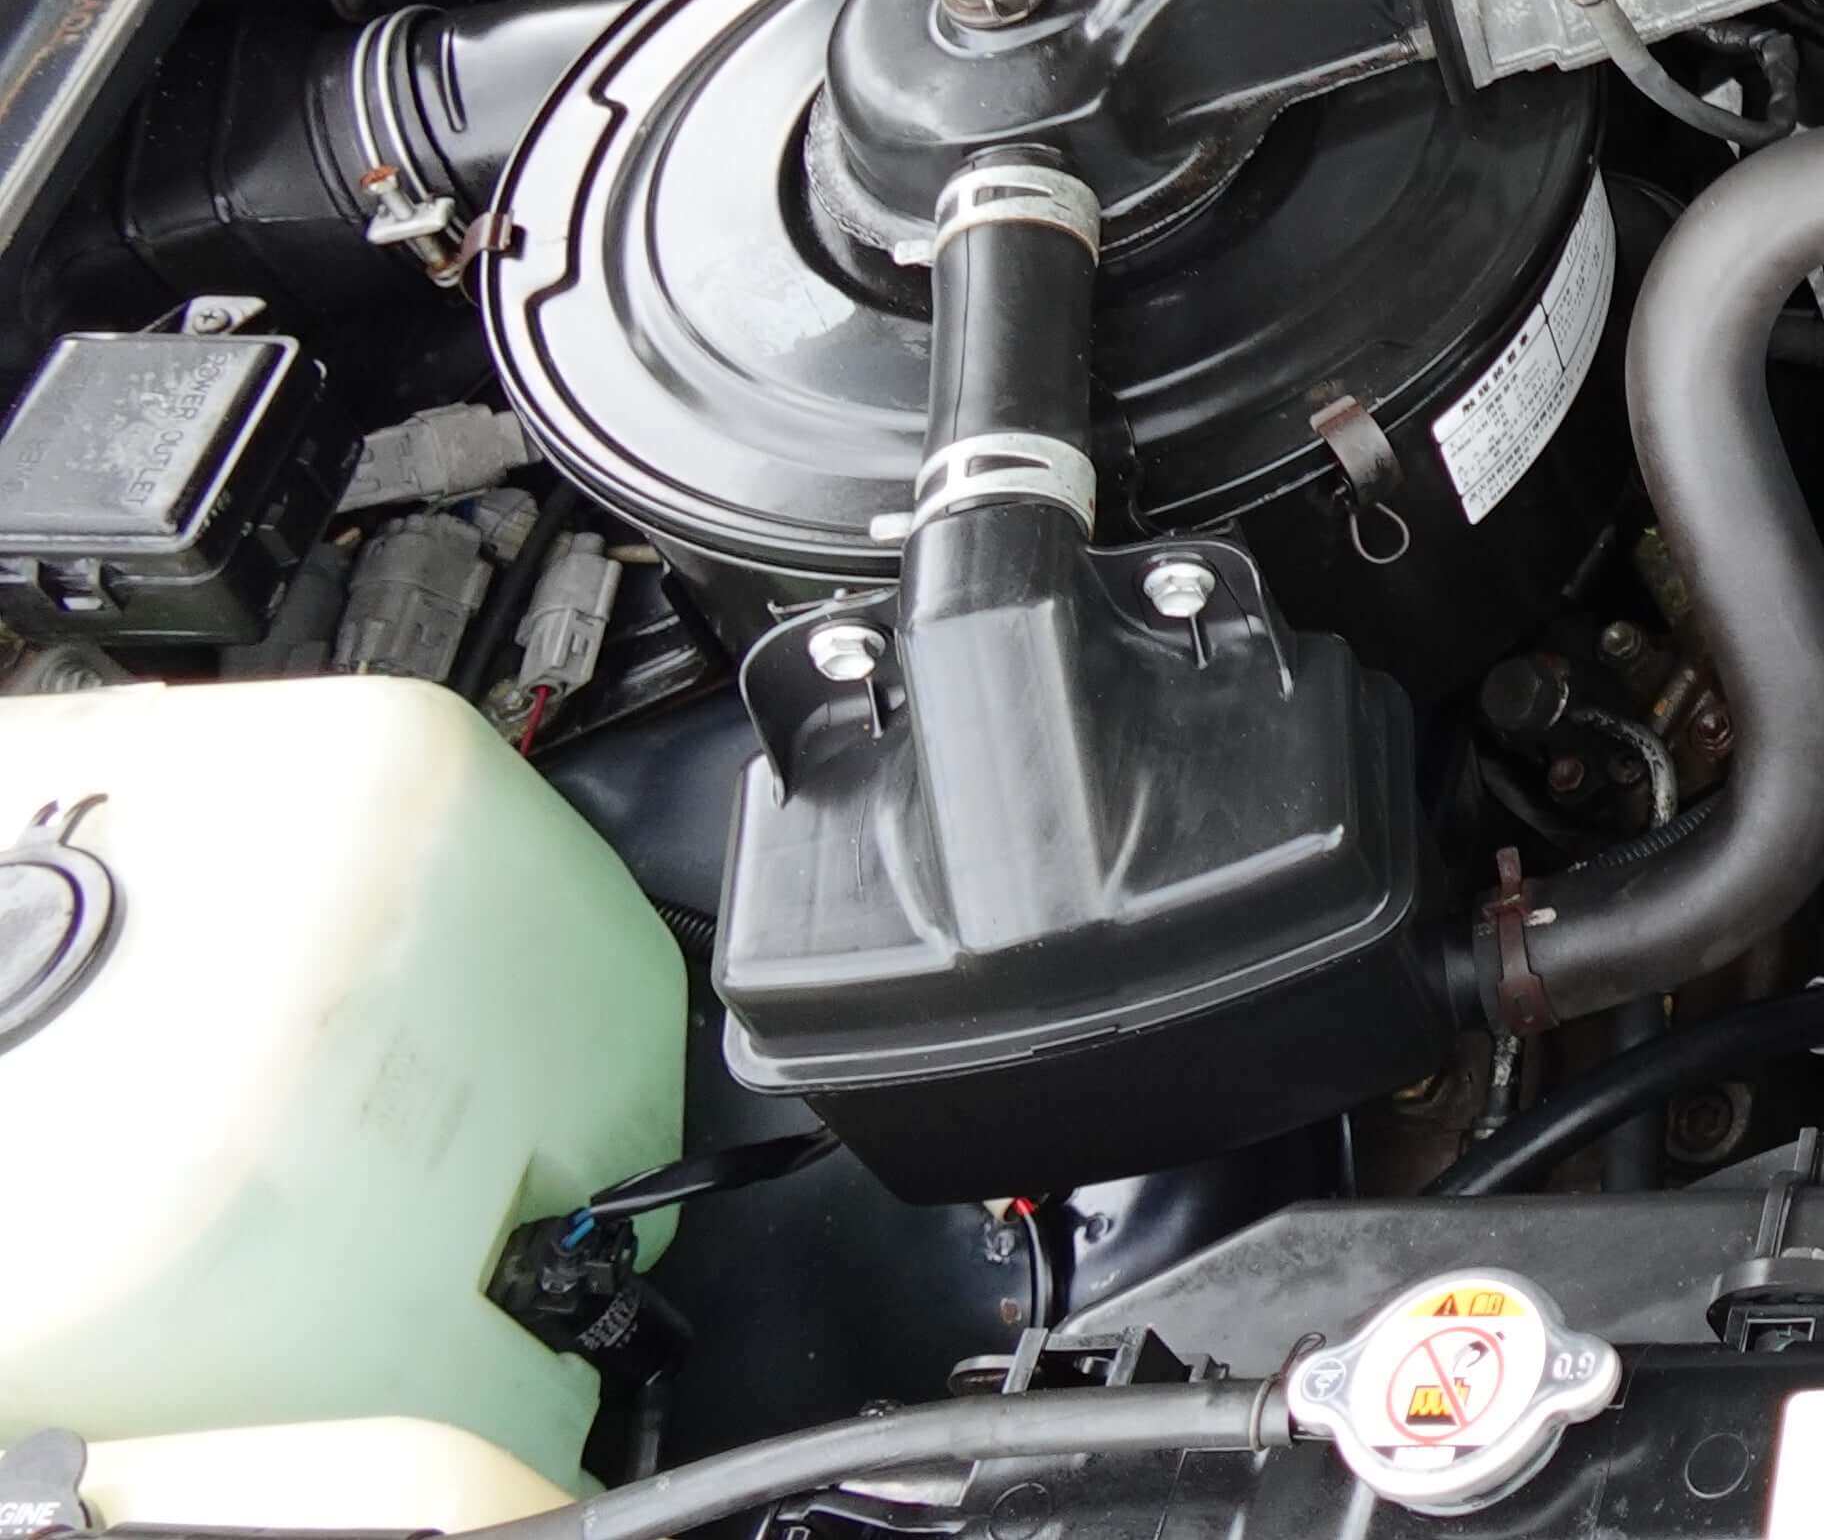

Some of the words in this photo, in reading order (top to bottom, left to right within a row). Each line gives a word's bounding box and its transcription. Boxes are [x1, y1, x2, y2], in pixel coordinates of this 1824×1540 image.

[178, 350, 235, 421] POWER
[124, 427, 184, 506] OUTLET
[1551, 1351, 1596, 1381] 0.9
[0, 1501, 62, 1526] GINE
